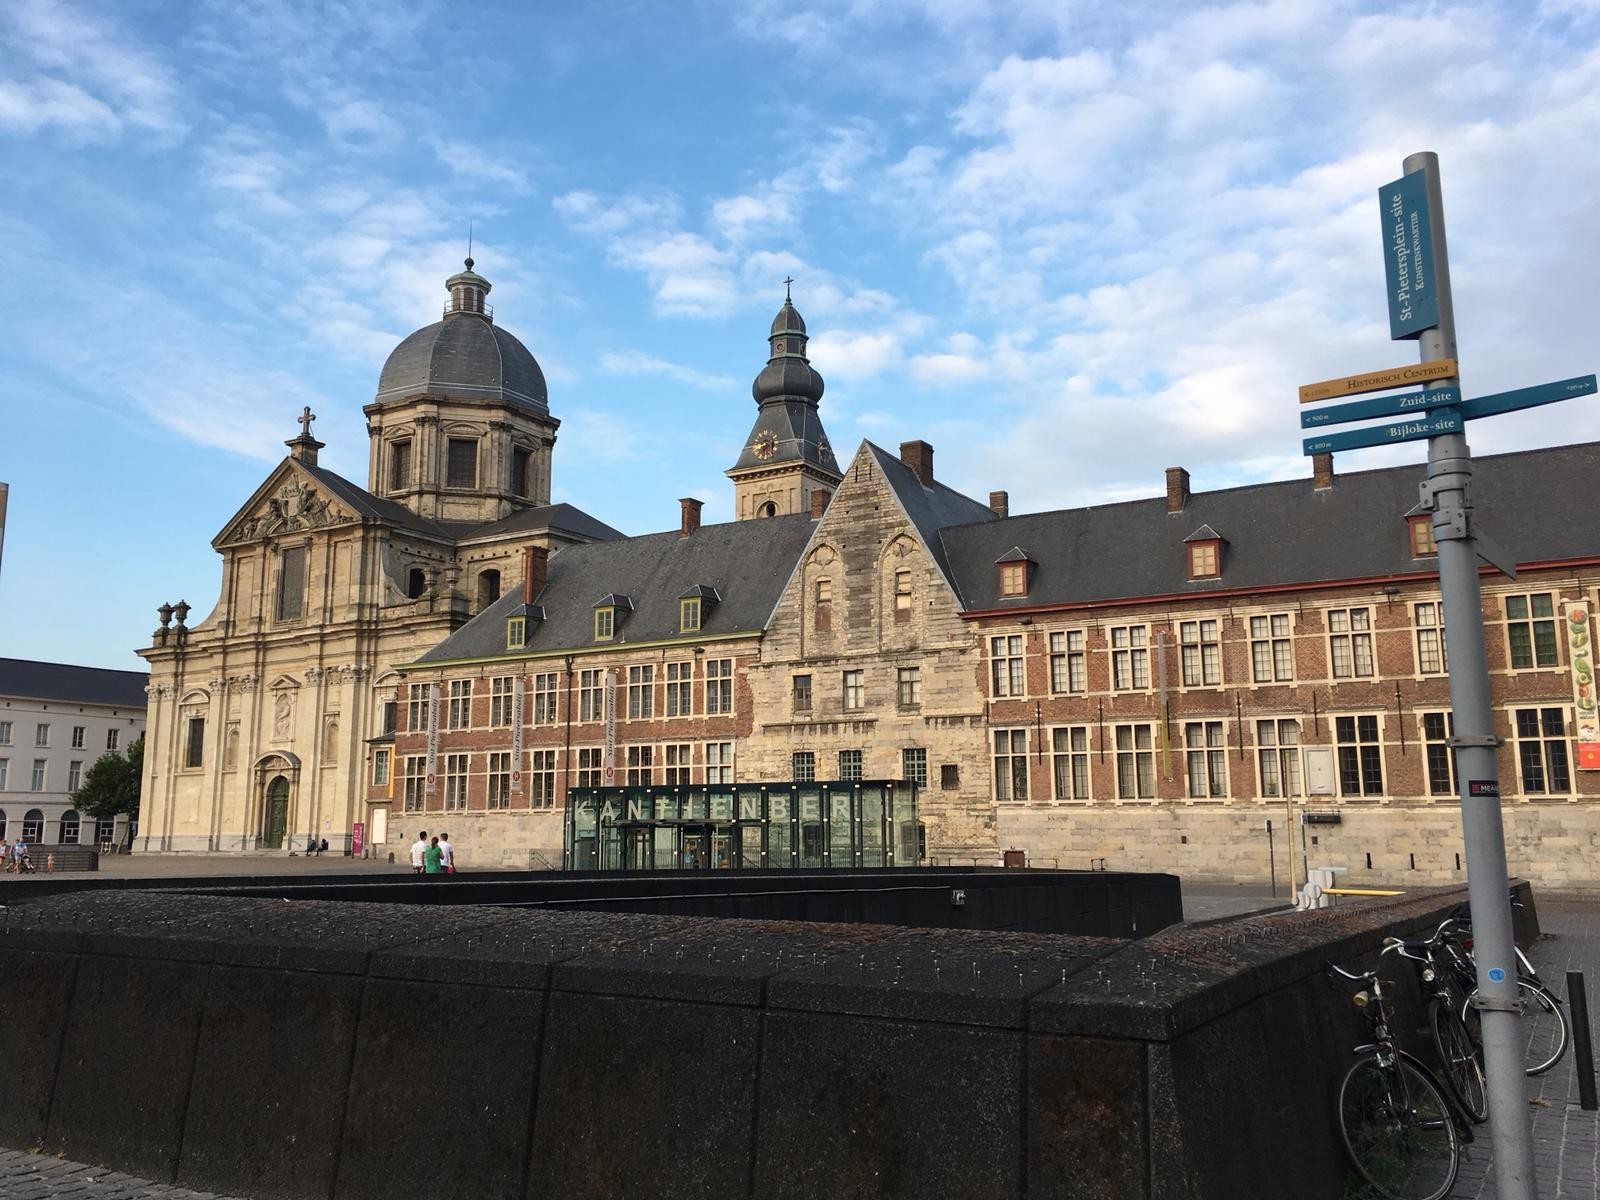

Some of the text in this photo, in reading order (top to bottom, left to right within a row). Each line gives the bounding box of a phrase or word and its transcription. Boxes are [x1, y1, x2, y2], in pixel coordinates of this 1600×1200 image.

[1391, 193, 1413, 321] St-Pietersplein-site
[1347, 365, 1449, 390] HISTORISCH CENTRUM
[1400, 392, 1452, 408] Zuid-site
[1389, 420, 1456, 438] Bijloke-site
